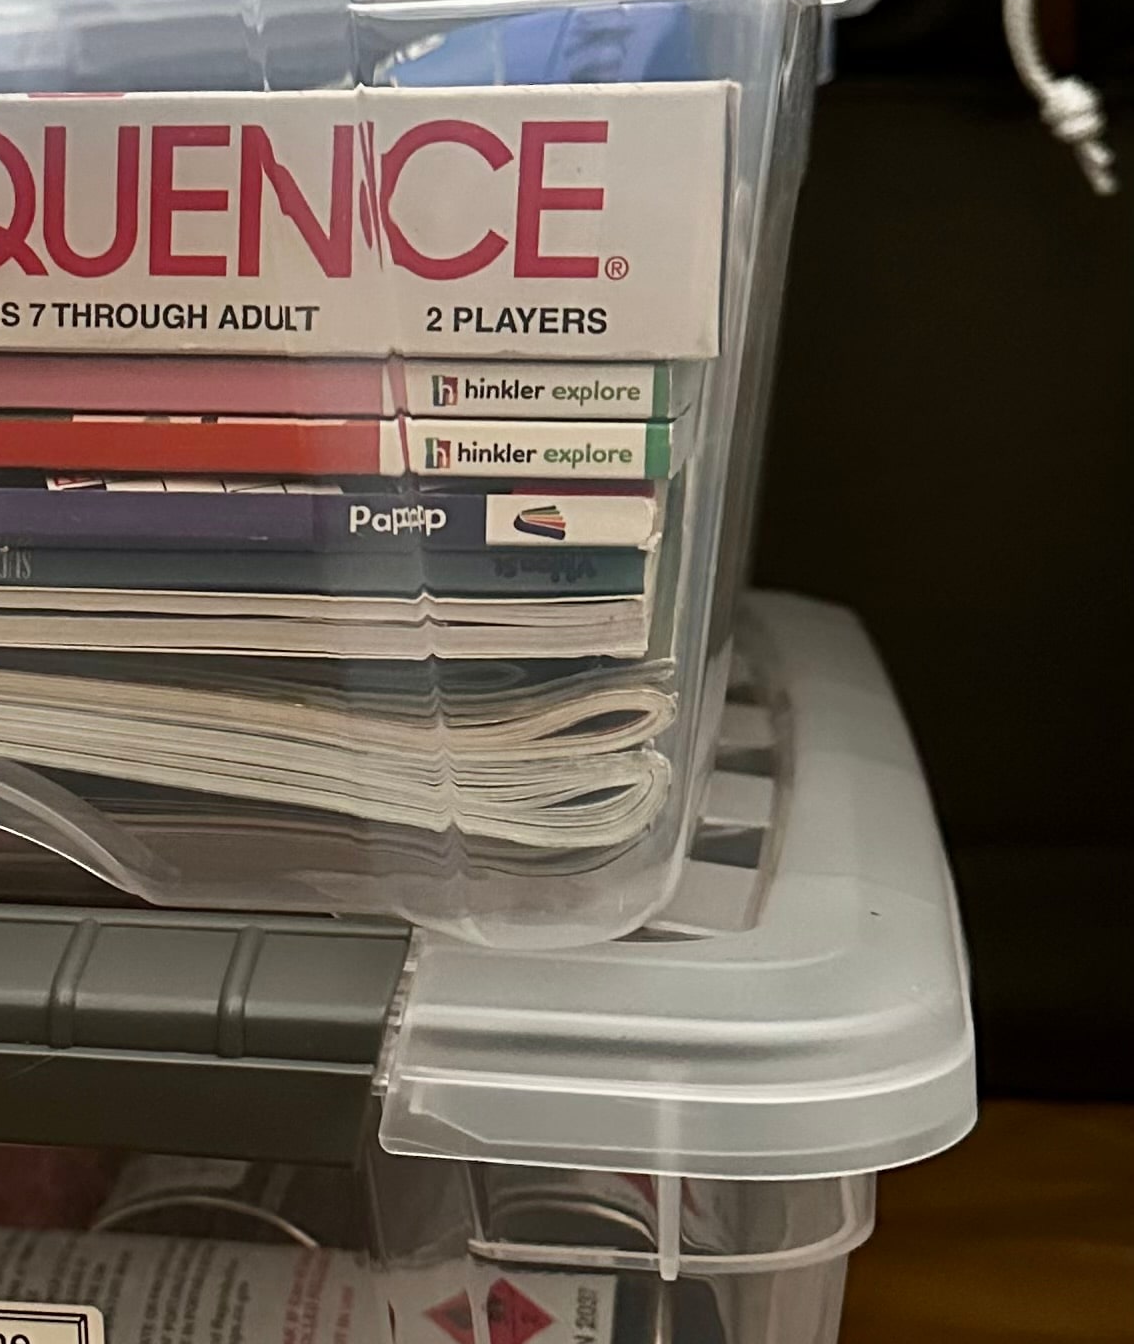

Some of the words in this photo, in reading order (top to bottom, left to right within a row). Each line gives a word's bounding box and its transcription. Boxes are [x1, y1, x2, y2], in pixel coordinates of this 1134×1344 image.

[29, 303, 47, 328] 7
[52, 303, 208, 329] THROUGH
[218, 304, 320, 332] ADULT
[426, 307, 443, 333] 2
[453, 307, 608, 335] PLAYERS
[465, 378, 546, 401] hinkler
[551, 380, 642, 406] explore
[457, 441, 538, 464] hinkler
[543, 443, 633, 469] explore
